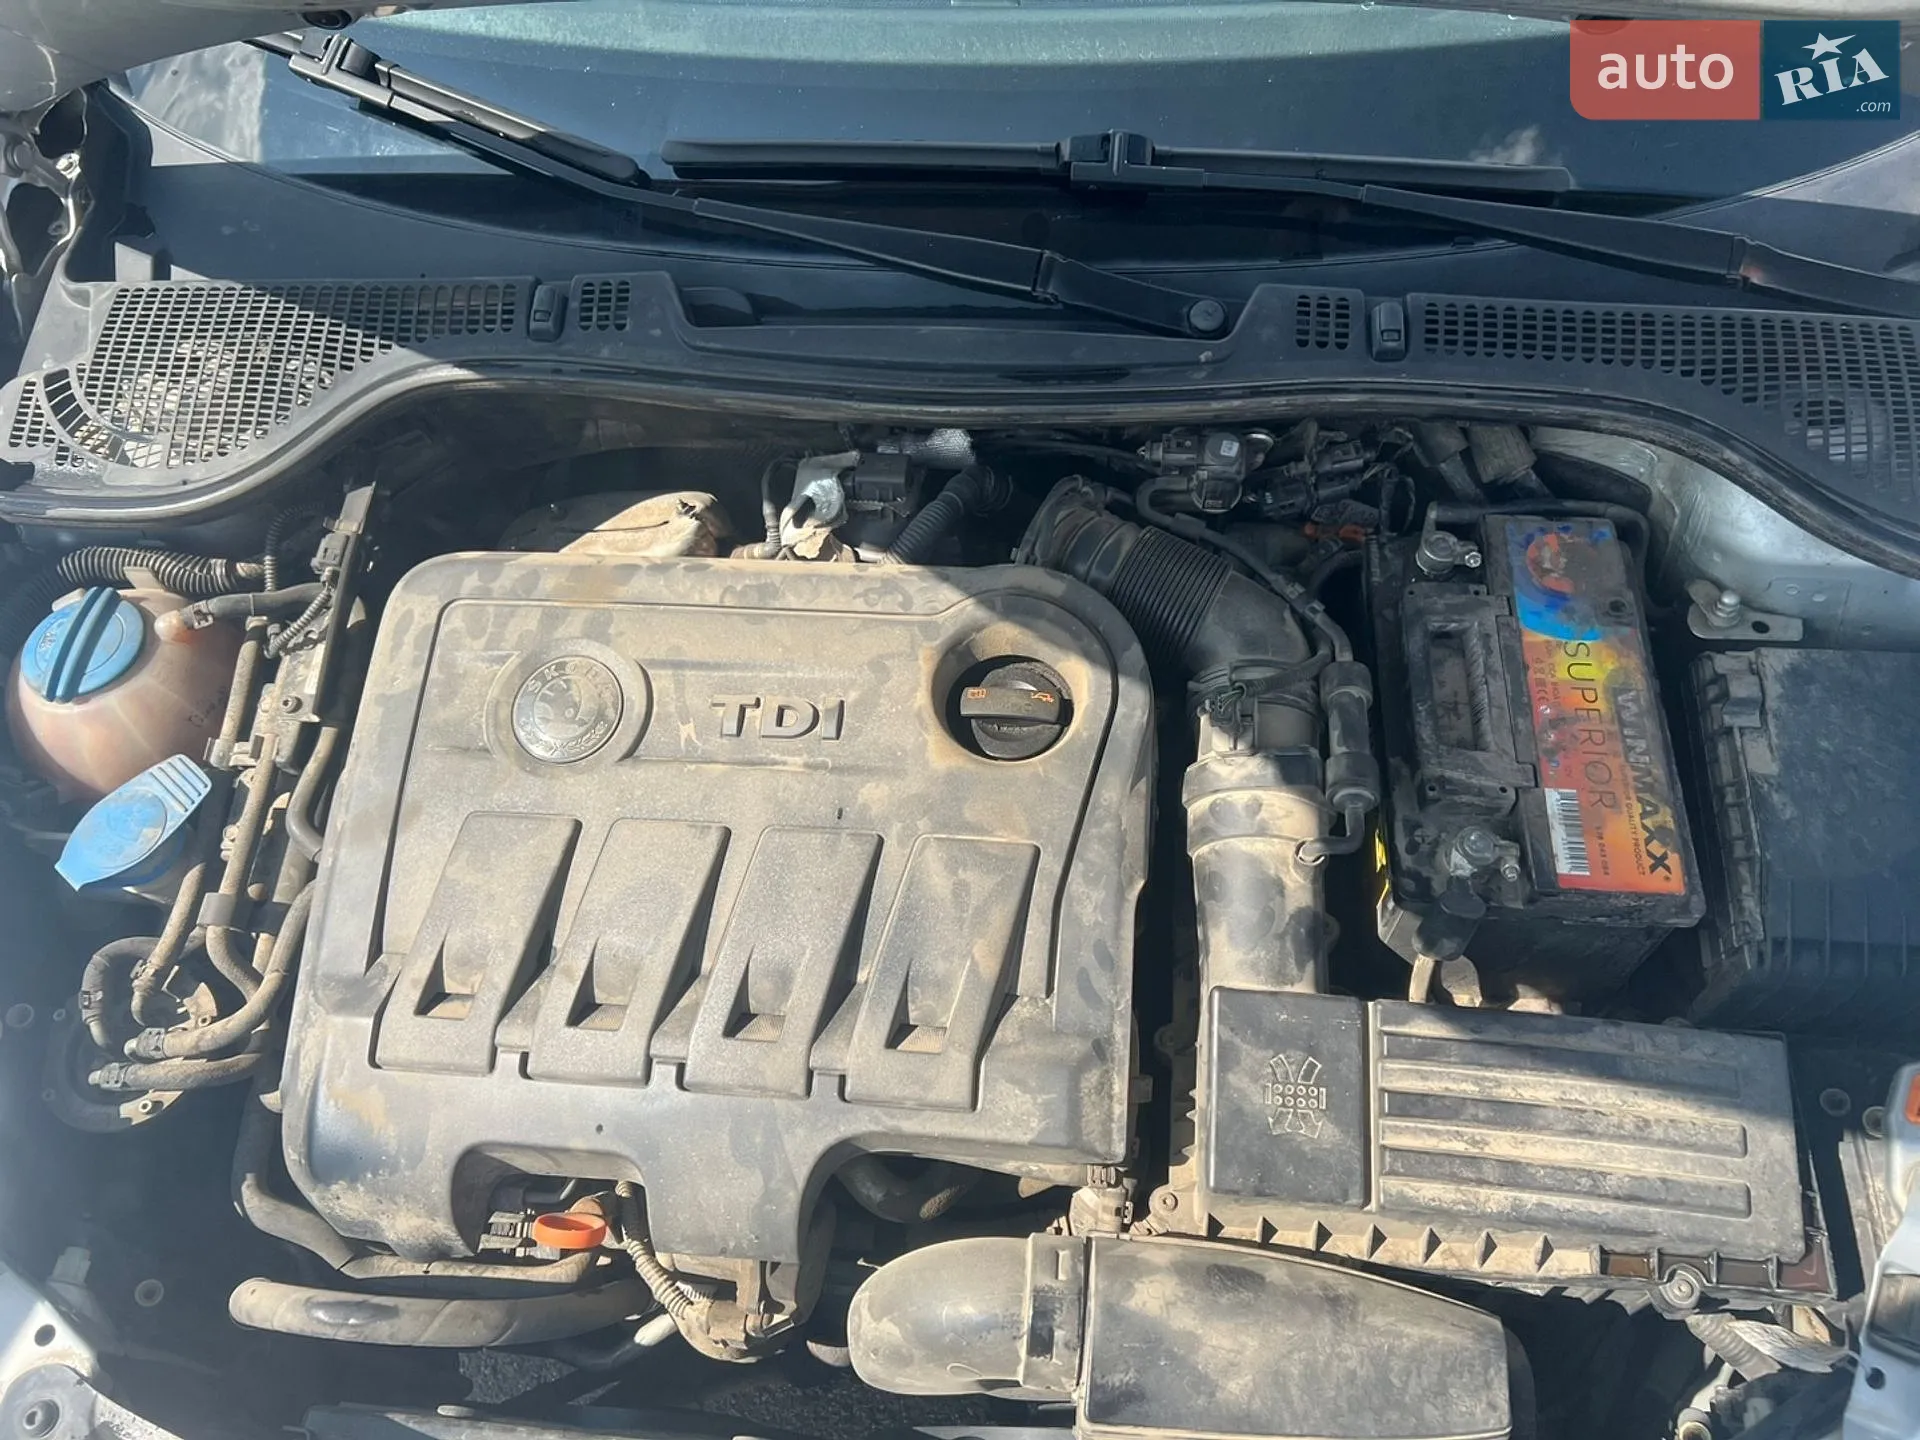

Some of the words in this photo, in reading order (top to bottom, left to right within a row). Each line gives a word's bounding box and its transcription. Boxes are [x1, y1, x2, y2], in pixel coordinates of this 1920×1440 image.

[709, 694, 846, 741] TDI
[1564, 641, 1616, 808] SUPERIOR
[1624, 802, 1637, 836] QUALITY
[1632, 837, 1645, 876] PRODUCT
